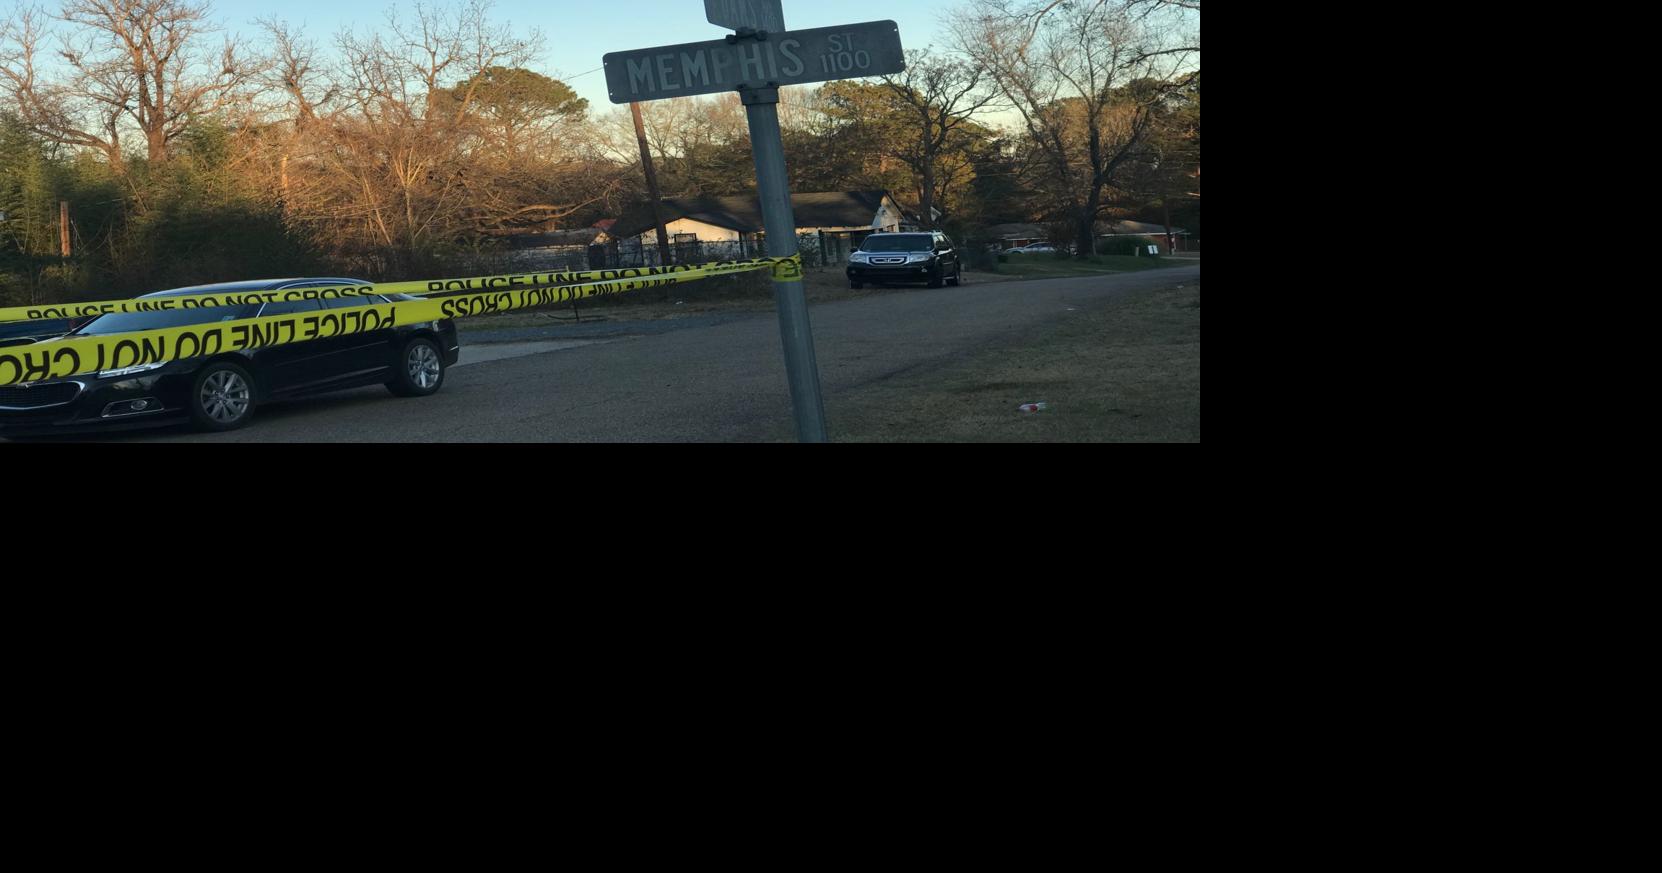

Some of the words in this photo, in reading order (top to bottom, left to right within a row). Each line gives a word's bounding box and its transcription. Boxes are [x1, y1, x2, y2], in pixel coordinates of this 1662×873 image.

[626, 40, 805, 94] MEMPHIS
[828, 32, 855, 53] ST
[820, 50, 871, 73] 1100
[441, 293, 513, 318] CROSS
[231, 319, 296, 349] LINE
[303, 307, 396, 339] POLICE
[95, 336, 165, 372] NOT
[173, 329, 222, 361] DO
